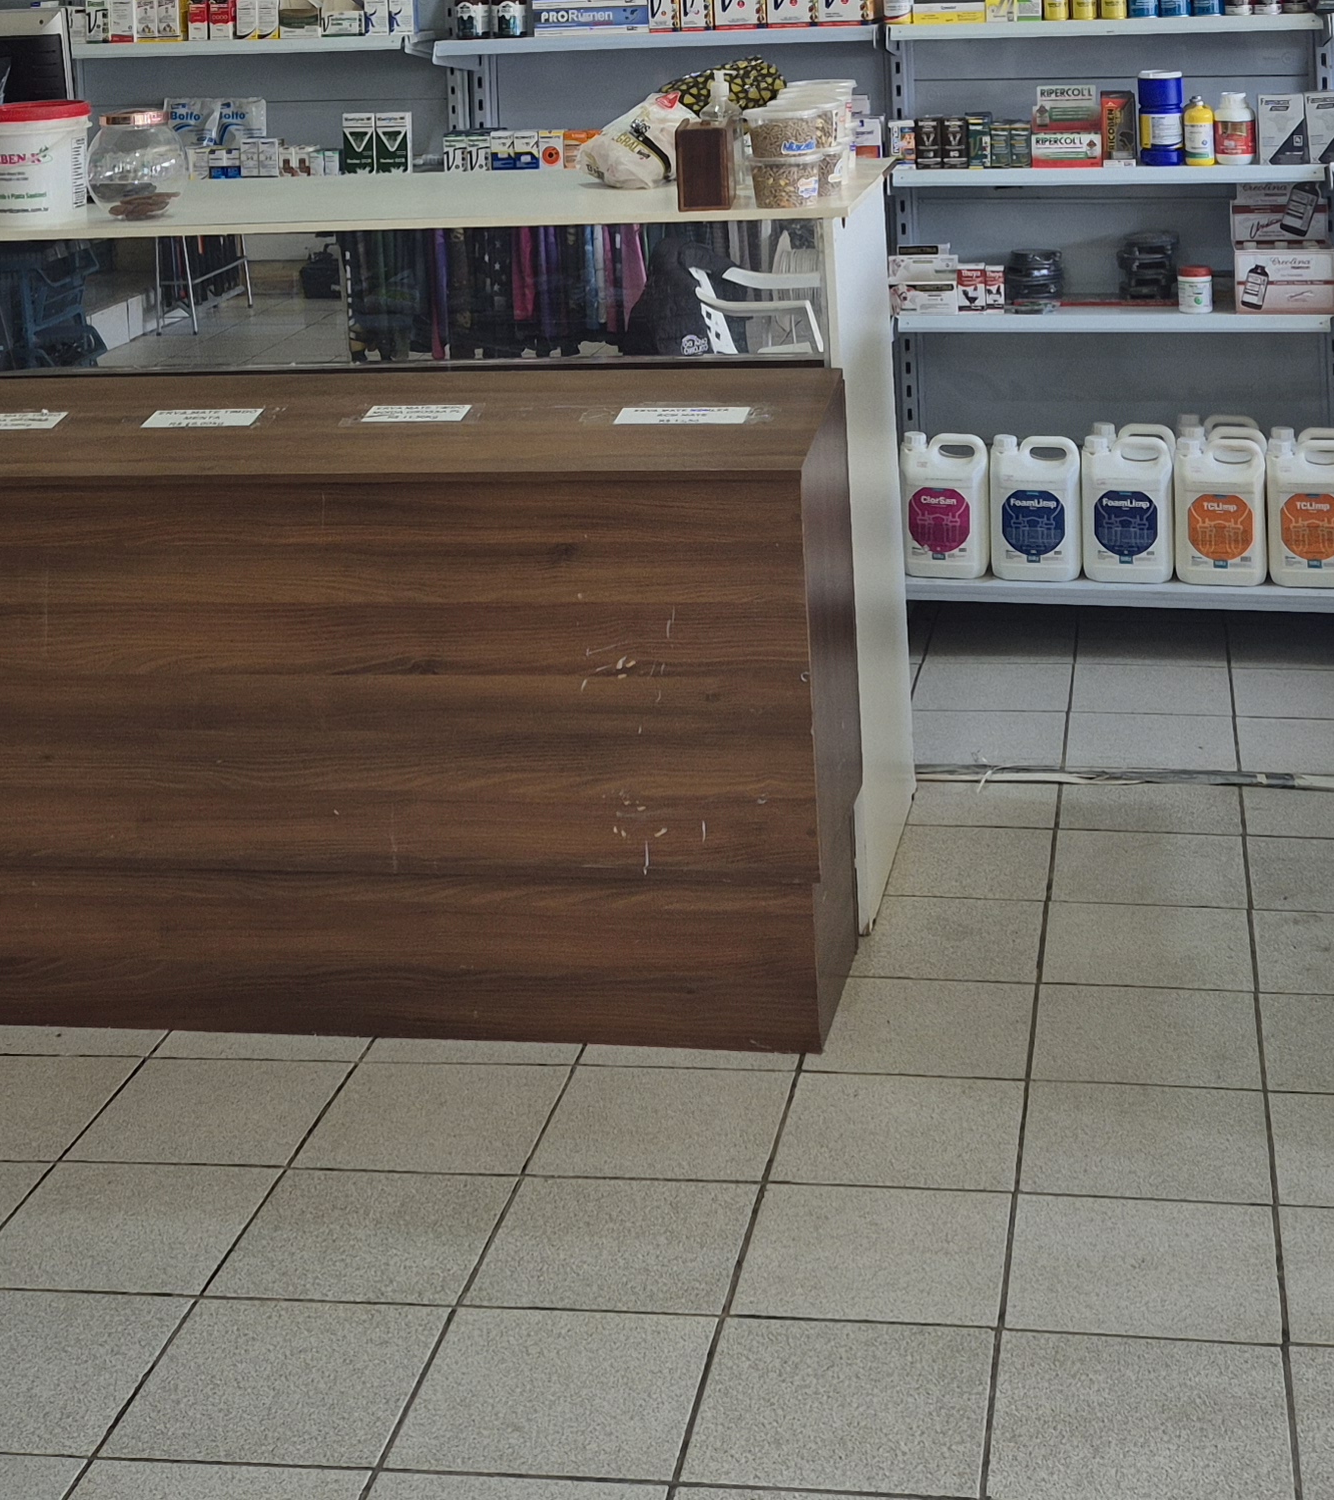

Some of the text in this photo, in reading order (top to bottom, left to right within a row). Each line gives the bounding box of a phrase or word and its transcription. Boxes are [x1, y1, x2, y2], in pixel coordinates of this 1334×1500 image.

[1040, 88, 1085, 98] RIPERCOL
[171, 112, 200, 120] Bolfo
[1035, 137, 1075, 145] RIPERCOL
[1010, 499, 1056, 508] FoamLimp
[1103, 499, 1149, 508] FoamLimp
[1203, 502, 1237, 511] TCLimp
[1296, 502, 1330, 510] TCLimp
